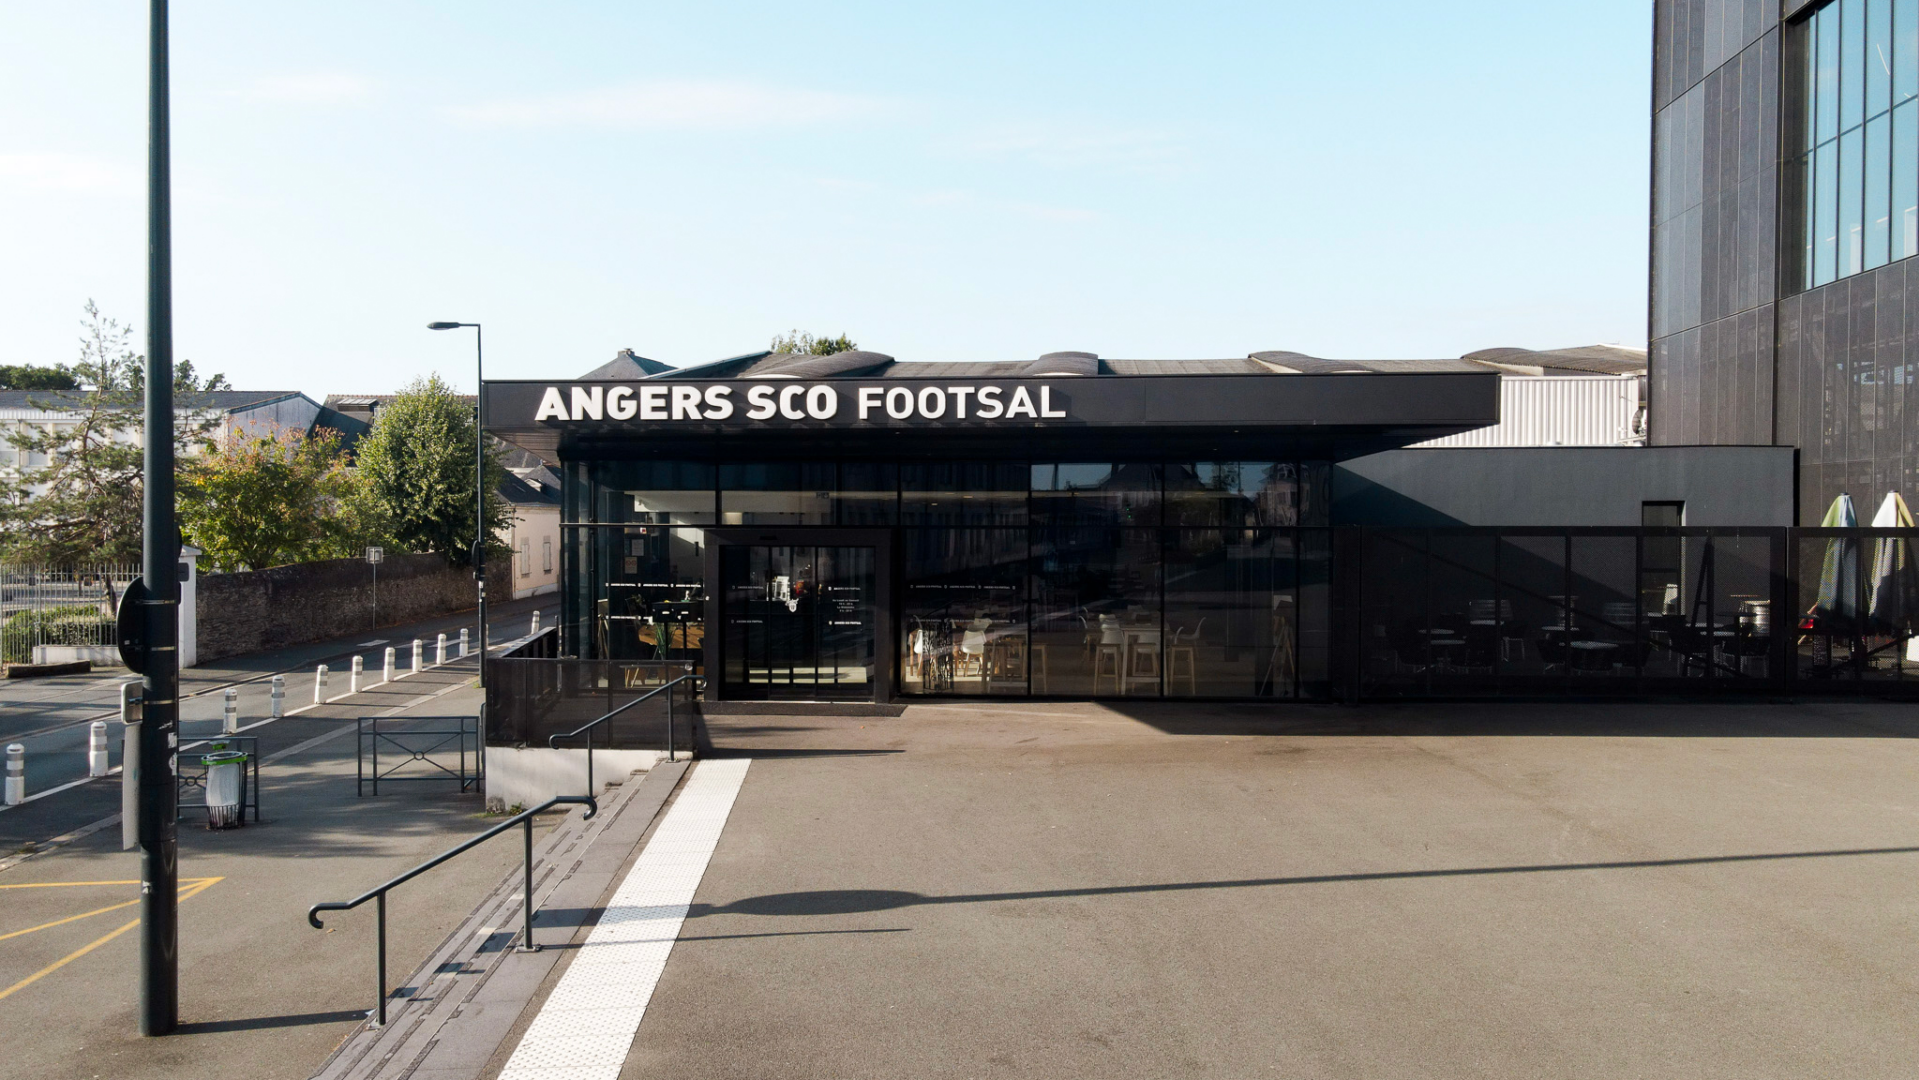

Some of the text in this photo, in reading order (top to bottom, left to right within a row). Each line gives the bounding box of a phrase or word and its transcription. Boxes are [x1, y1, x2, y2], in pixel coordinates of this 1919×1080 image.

[535, 385, 1066, 420] ANGERS SCO FOOTSAL
